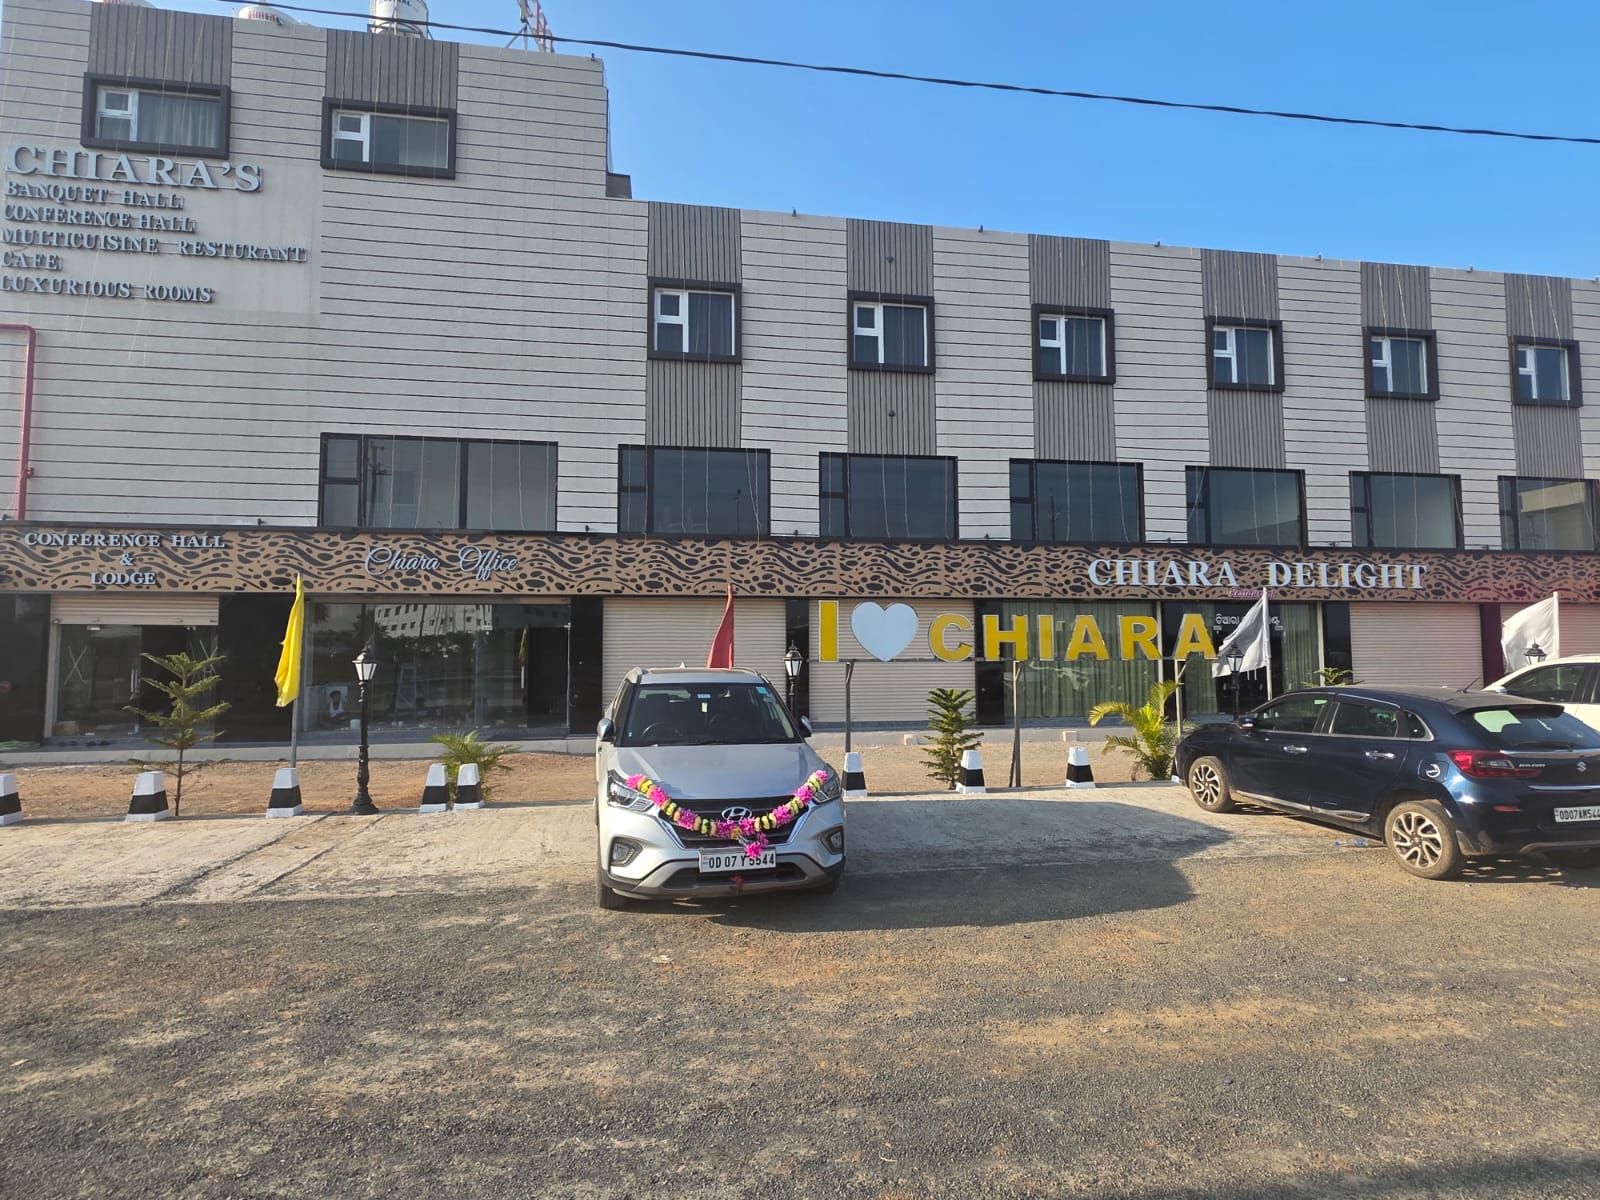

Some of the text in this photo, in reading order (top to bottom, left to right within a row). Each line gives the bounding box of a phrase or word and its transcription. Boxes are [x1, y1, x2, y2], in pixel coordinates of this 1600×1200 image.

[6, 181, 184, 209] BANQUET HALL
[4, 204, 196, 232] CONFERENCE HALL
[1, 228, 307, 262] MULTICUISINE RESTURANT
[1, 250, 63, 270] CAFE
[0, 275, 215, 303] LUXURIOUS ROOMS
[24, 533, 226, 548] CONFERENCE HALL
[119, 553, 133, 566] &
[364, 545, 519, 582] Chiara Office
[90, 572, 157, 586] LODGE
[1087, 559, 1428, 590] CHIARA DELIGHT
[928, 613, 1219, 662] CHIARA
